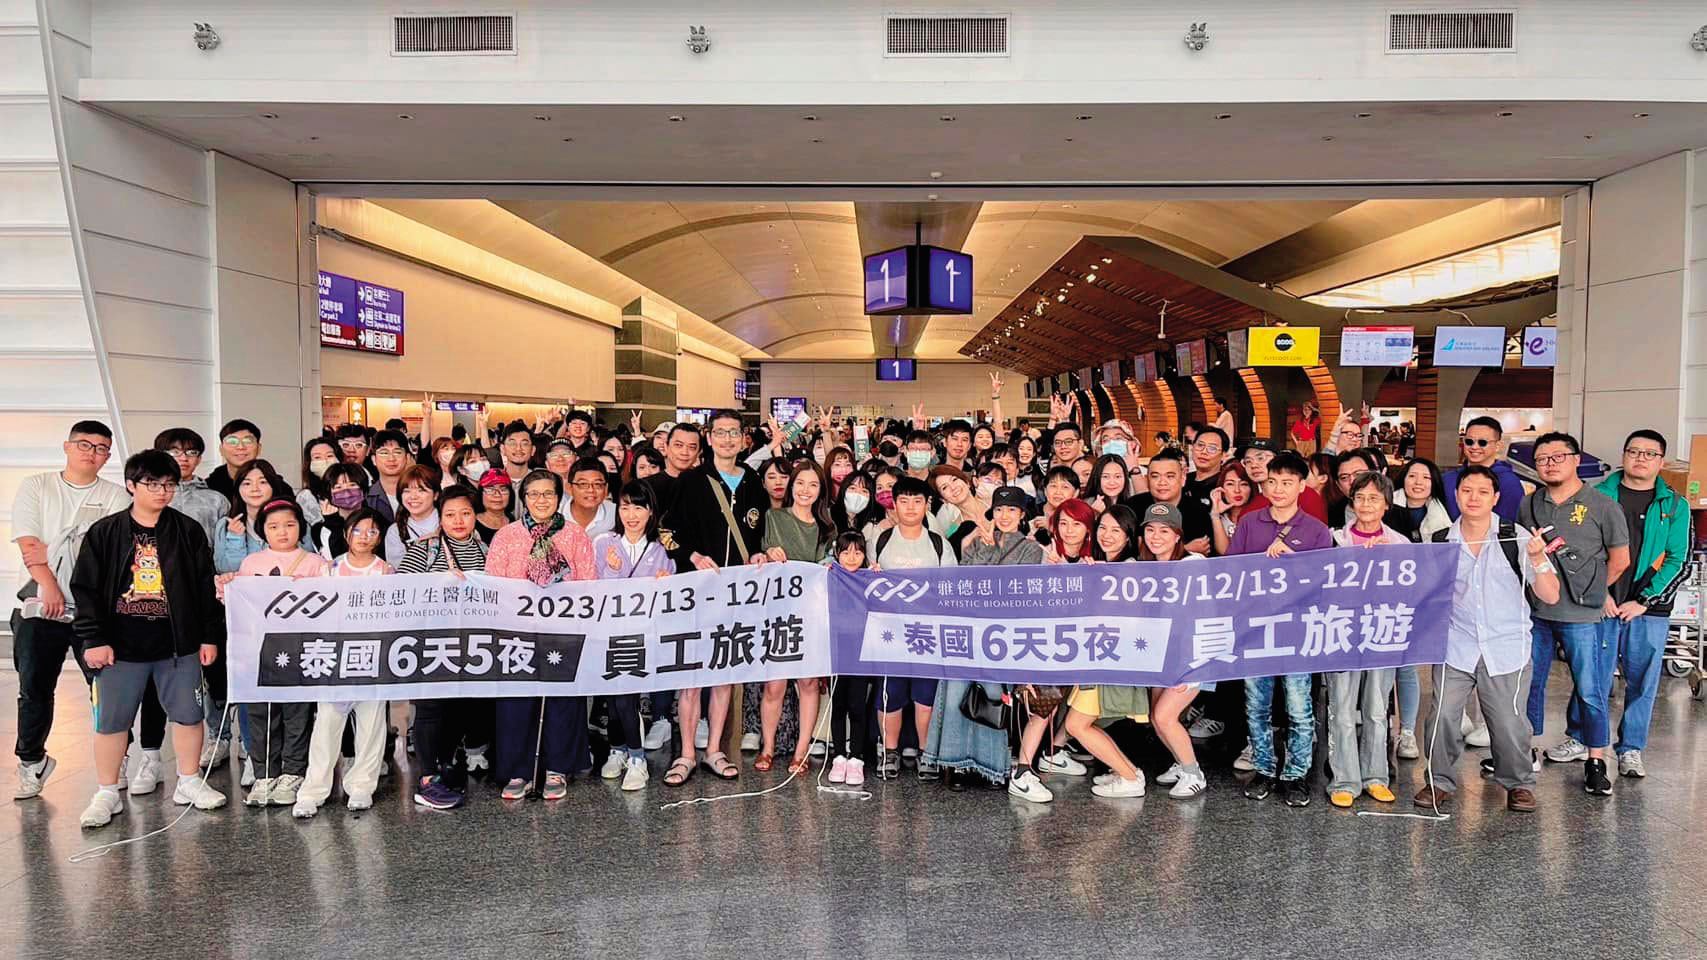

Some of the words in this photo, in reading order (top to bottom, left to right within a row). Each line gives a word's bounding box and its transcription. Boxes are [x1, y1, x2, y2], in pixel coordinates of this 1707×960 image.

[880, 259, 889, 302] 1
[892, 361, 899, 378] 1
[517, 587, 696, 622] 2023/12/13
[727, 575, 803, 607] 12/18
[938, 600, 980, 608] ARTISTIC
[983, 599, 1045, 608] BIOMEDICAL
[1048, 597, 1084, 607] GROUP
[1101, 568, 1288, 605] 2023/12/13
[1322, 559, 1417, 590] 12/18
[345, 611, 391, 621] ARTISTIC
[395, 608, 459, 619] BIOMEDICAL
[463, 607, 500, 617] GROUP
[1188, 602, 1415, 669] 員工旅遊
[300, 634, 536, 679] 泰國6天5夜
[602, 614, 804, 680] 員工旅遊
[904, 621, 1121, 663] 泰國6天5夜
